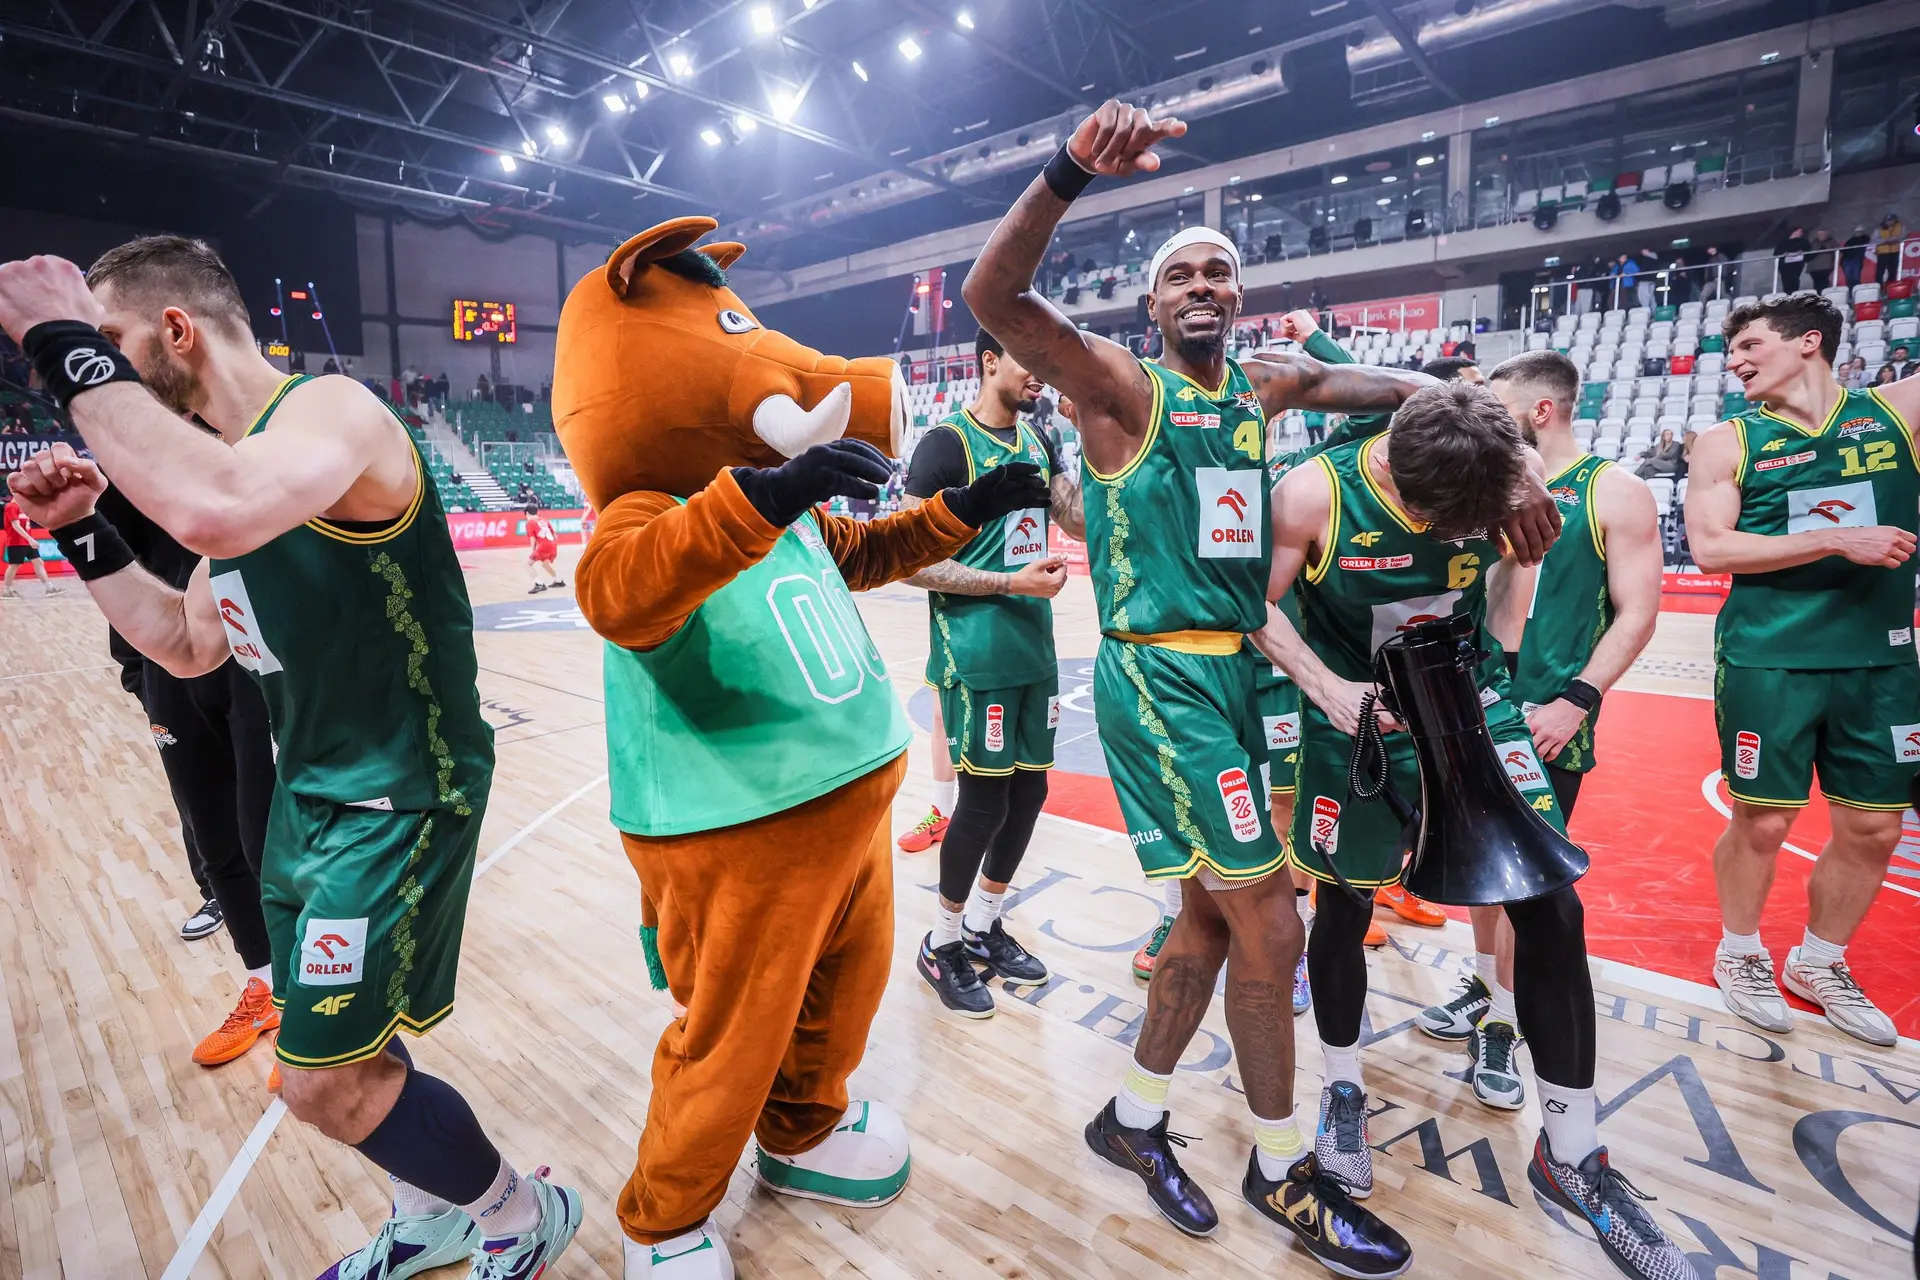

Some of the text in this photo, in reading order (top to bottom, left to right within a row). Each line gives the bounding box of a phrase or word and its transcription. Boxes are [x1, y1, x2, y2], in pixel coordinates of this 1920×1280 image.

[1233, 420, 1262, 460] 4
[1761, 437, 1788, 452] 4F
[1757, 459, 1786, 470] ORLEN
[1838, 440, 1898, 477] 12
[1575, 468, 1590, 482] C
[1211, 528, 1255, 544] ORLEN
[1350, 531, 1384, 548] 4F
[73, 532, 95, 563] 7
[1012, 542, 1042, 556] ORLEN
[1340, 558, 1373, 569] ORLEN
[1447, 552, 1481, 590] 6
[1272, 735, 1299, 744] ORLEN
[1903, 749, 1920, 758] ORL
[1222, 776, 1246, 789] ORLEN
[1316, 803, 1338, 814] ORLEN
[1234, 818, 1257, 831] Basket
[1241, 827, 1257, 836] Liga
[1129, 828, 1163, 850] ptus
[306, 963, 353, 975] ORLEN
[311, 993, 356, 1016] 4F
